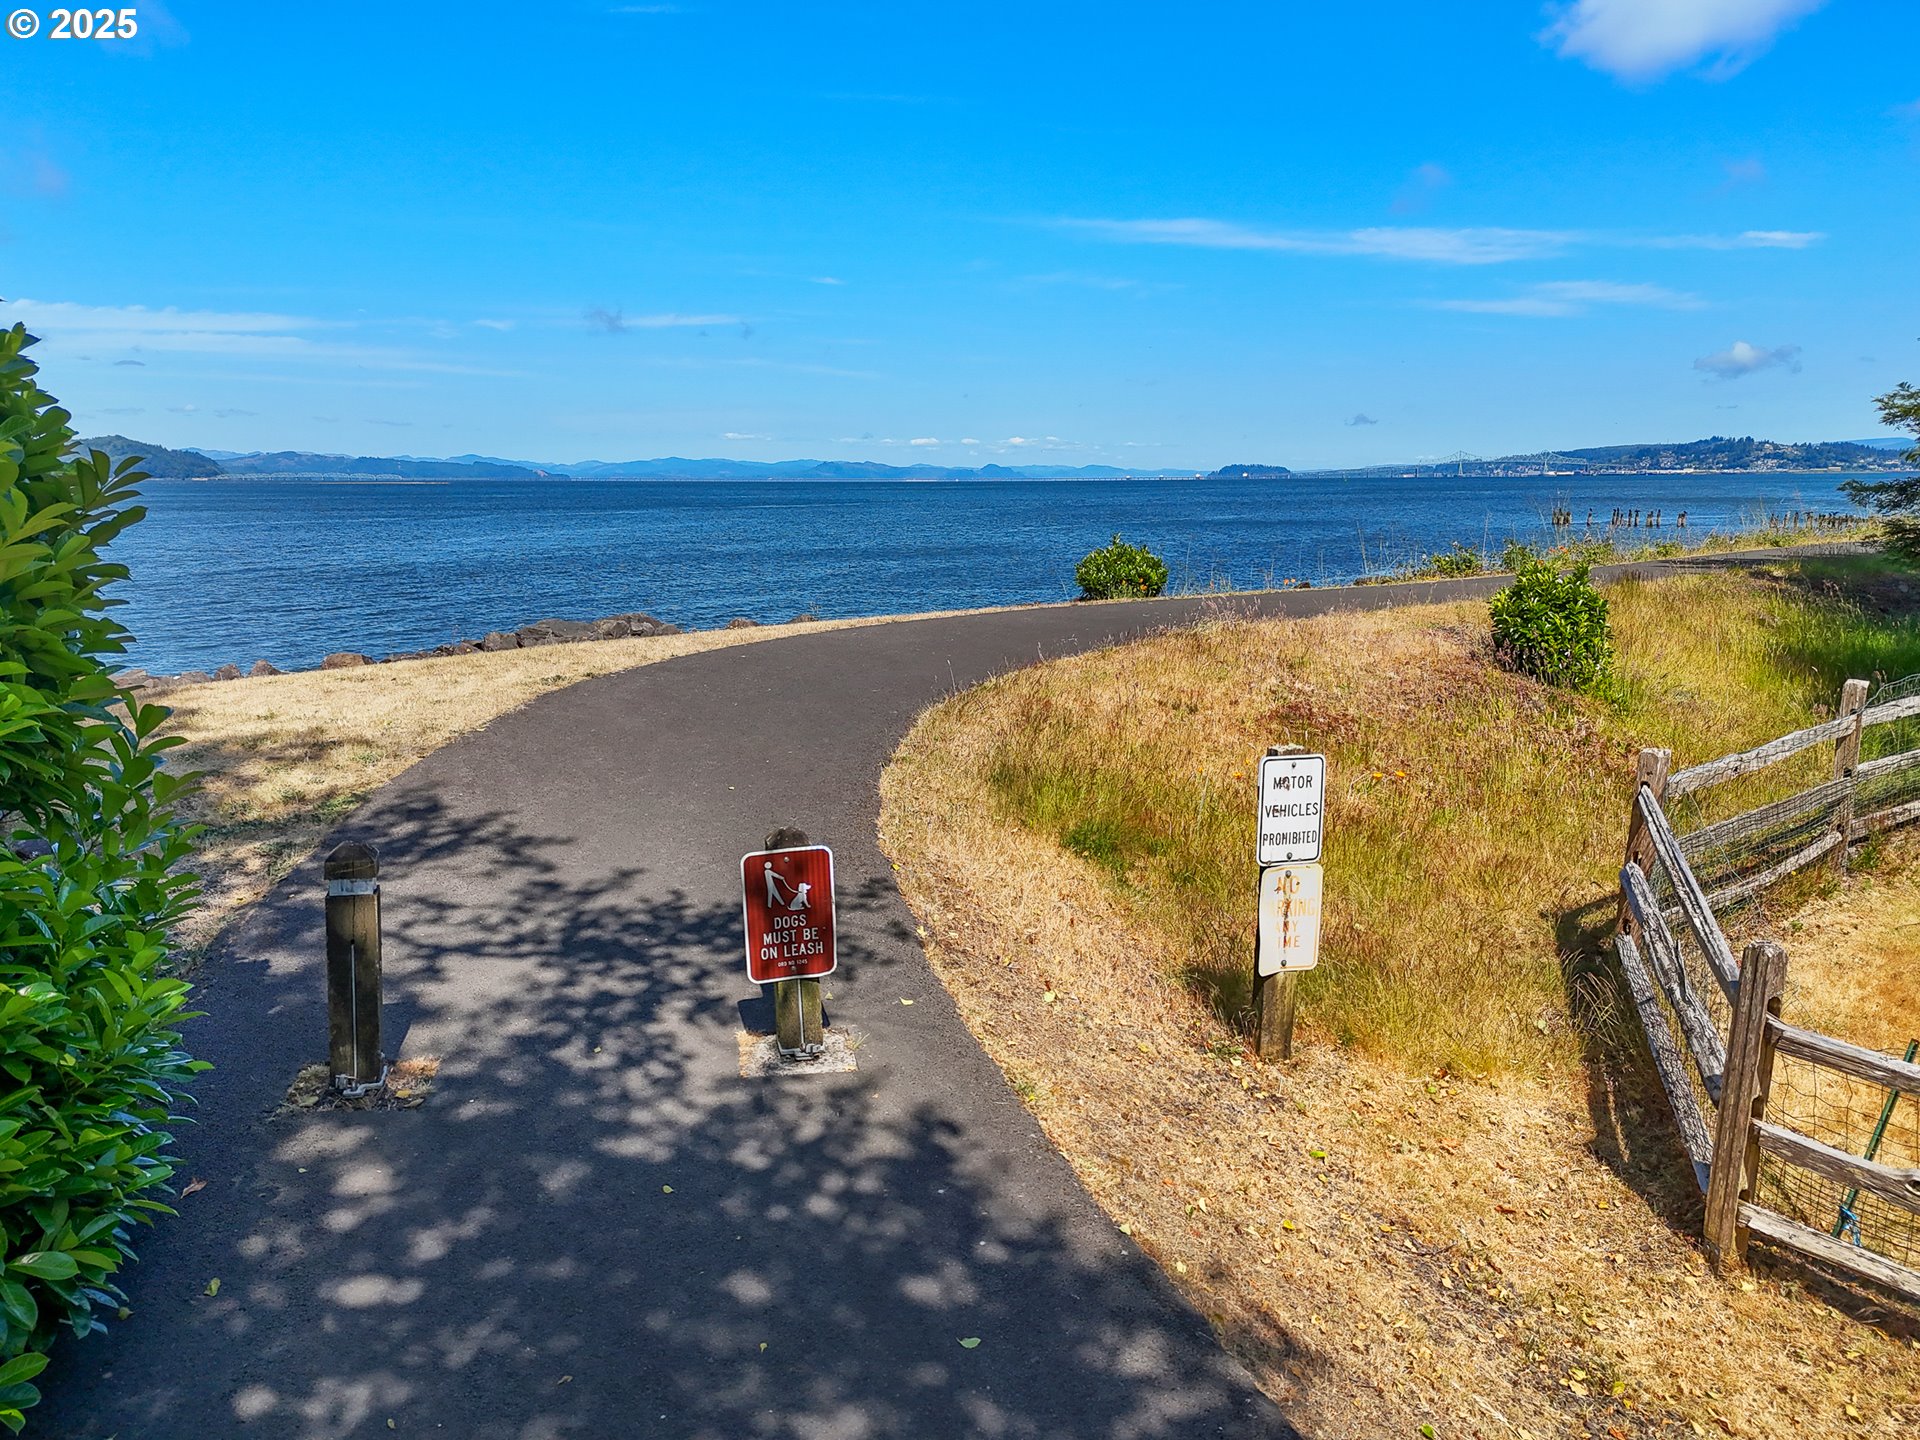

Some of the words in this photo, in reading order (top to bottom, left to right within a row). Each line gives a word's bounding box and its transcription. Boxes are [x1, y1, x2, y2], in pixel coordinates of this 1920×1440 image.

[1273, 775, 1313, 790] MOTOR
[1265, 802, 1319, 818] VEHICLES
[1262, 830, 1318, 846] PROHIBITED
[774, 914, 807, 930] DOGS
[763, 929, 797, 946] MUST
[803, 927, 819, 941] BE
[761, 946, 778, 960] ON
[784, 941, 824, 957] LEASH
